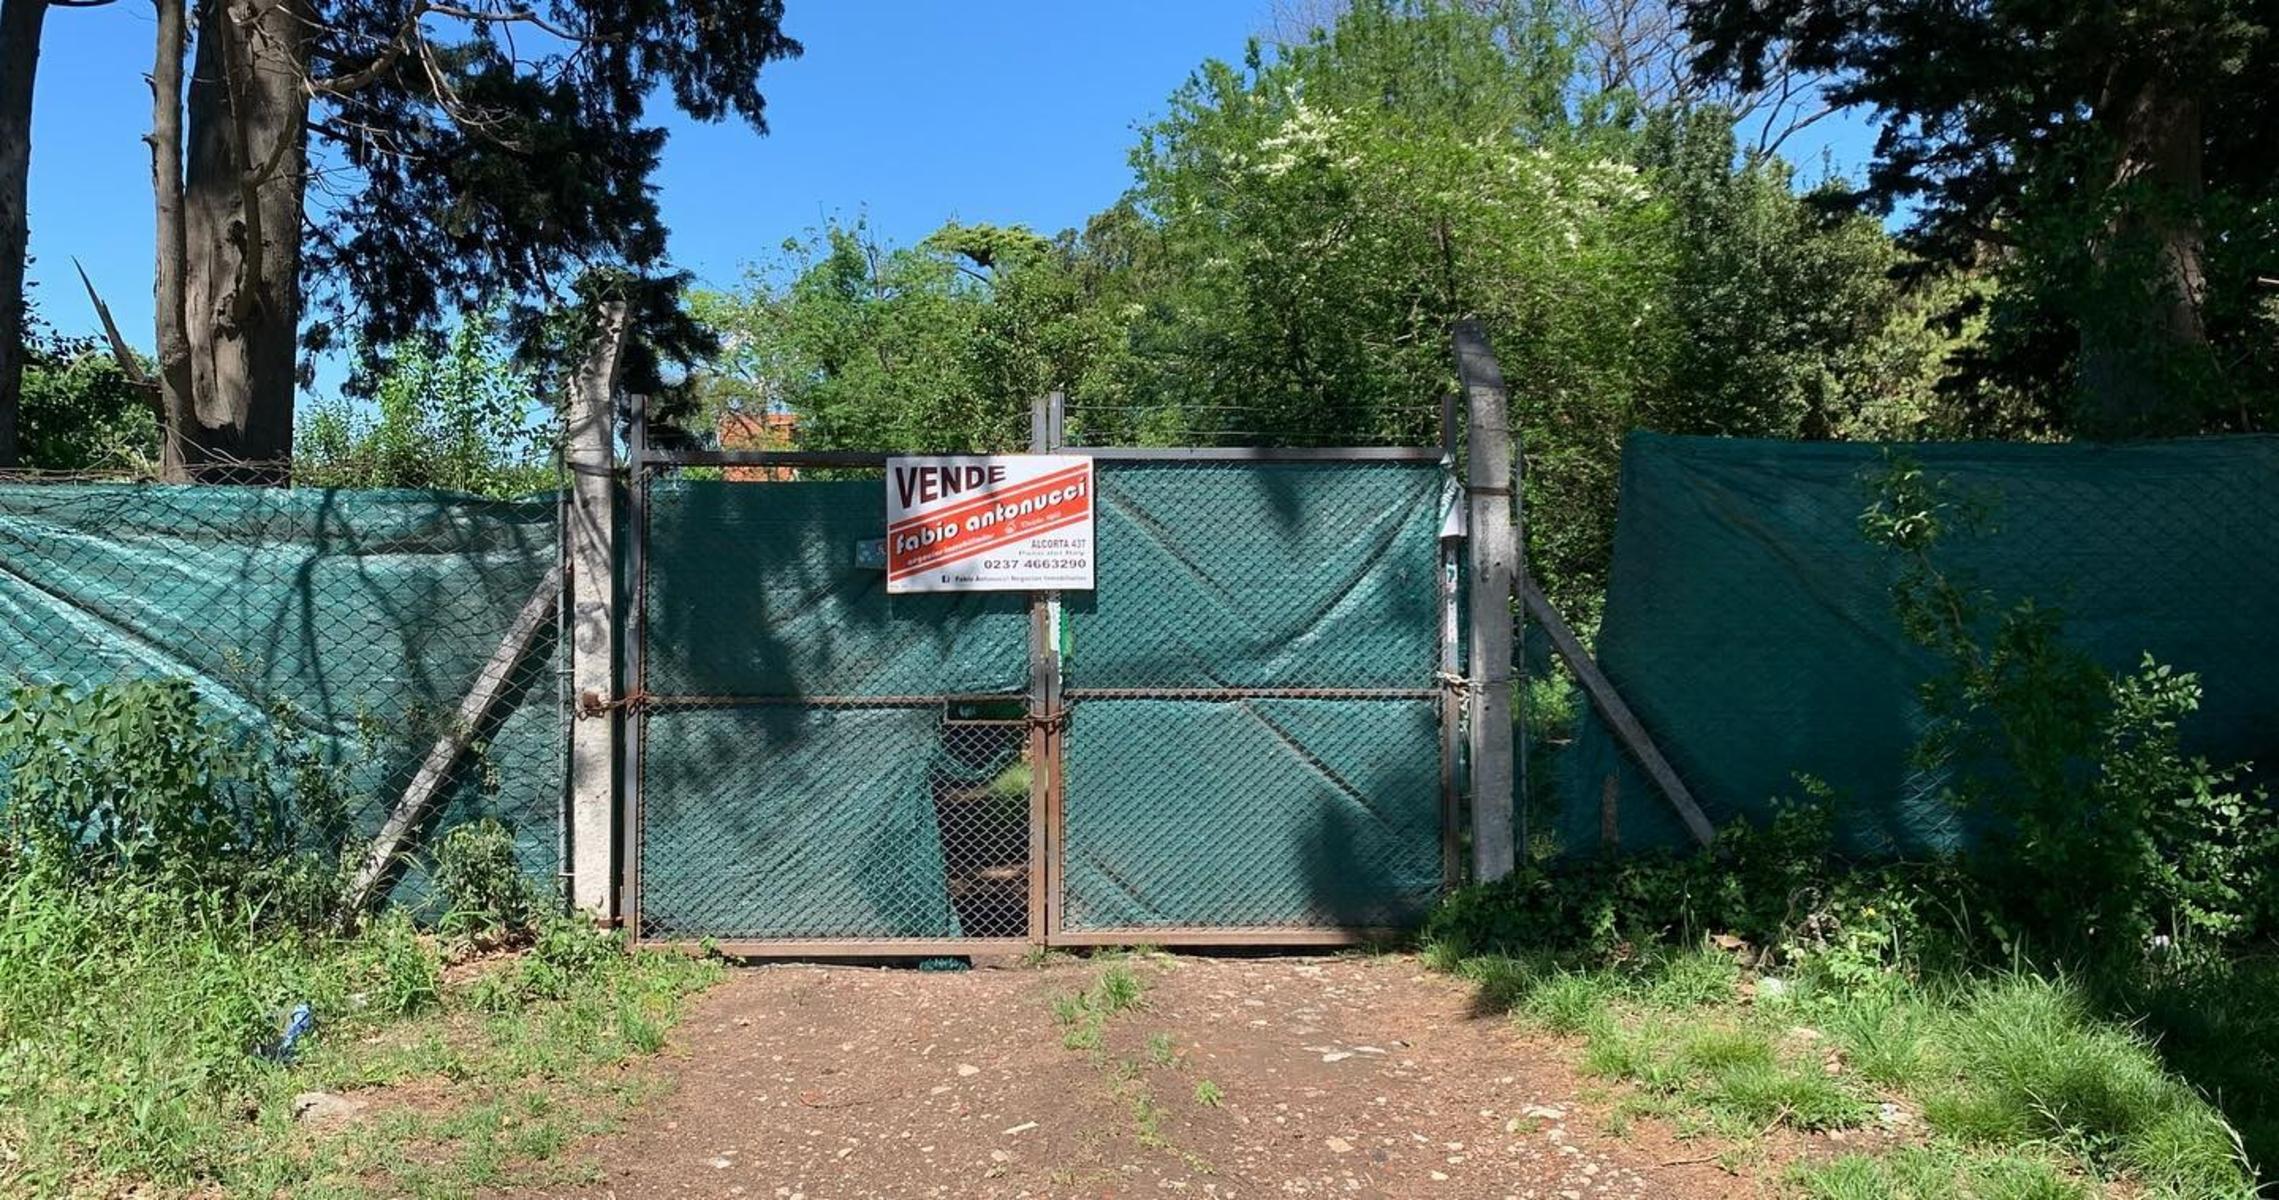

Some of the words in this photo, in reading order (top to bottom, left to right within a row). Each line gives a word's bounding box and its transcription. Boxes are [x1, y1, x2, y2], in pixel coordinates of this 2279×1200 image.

[896, 465, 1006, 509] VENDE
[896, 521, 958, 555] fabio
[966, 477, 1087, 531] antonucci
[1031, 539, 1069, 548] ALCORTA
[984, 559, 1019, 569] 0237
[1023, 559, 1087, 569] 4663290
